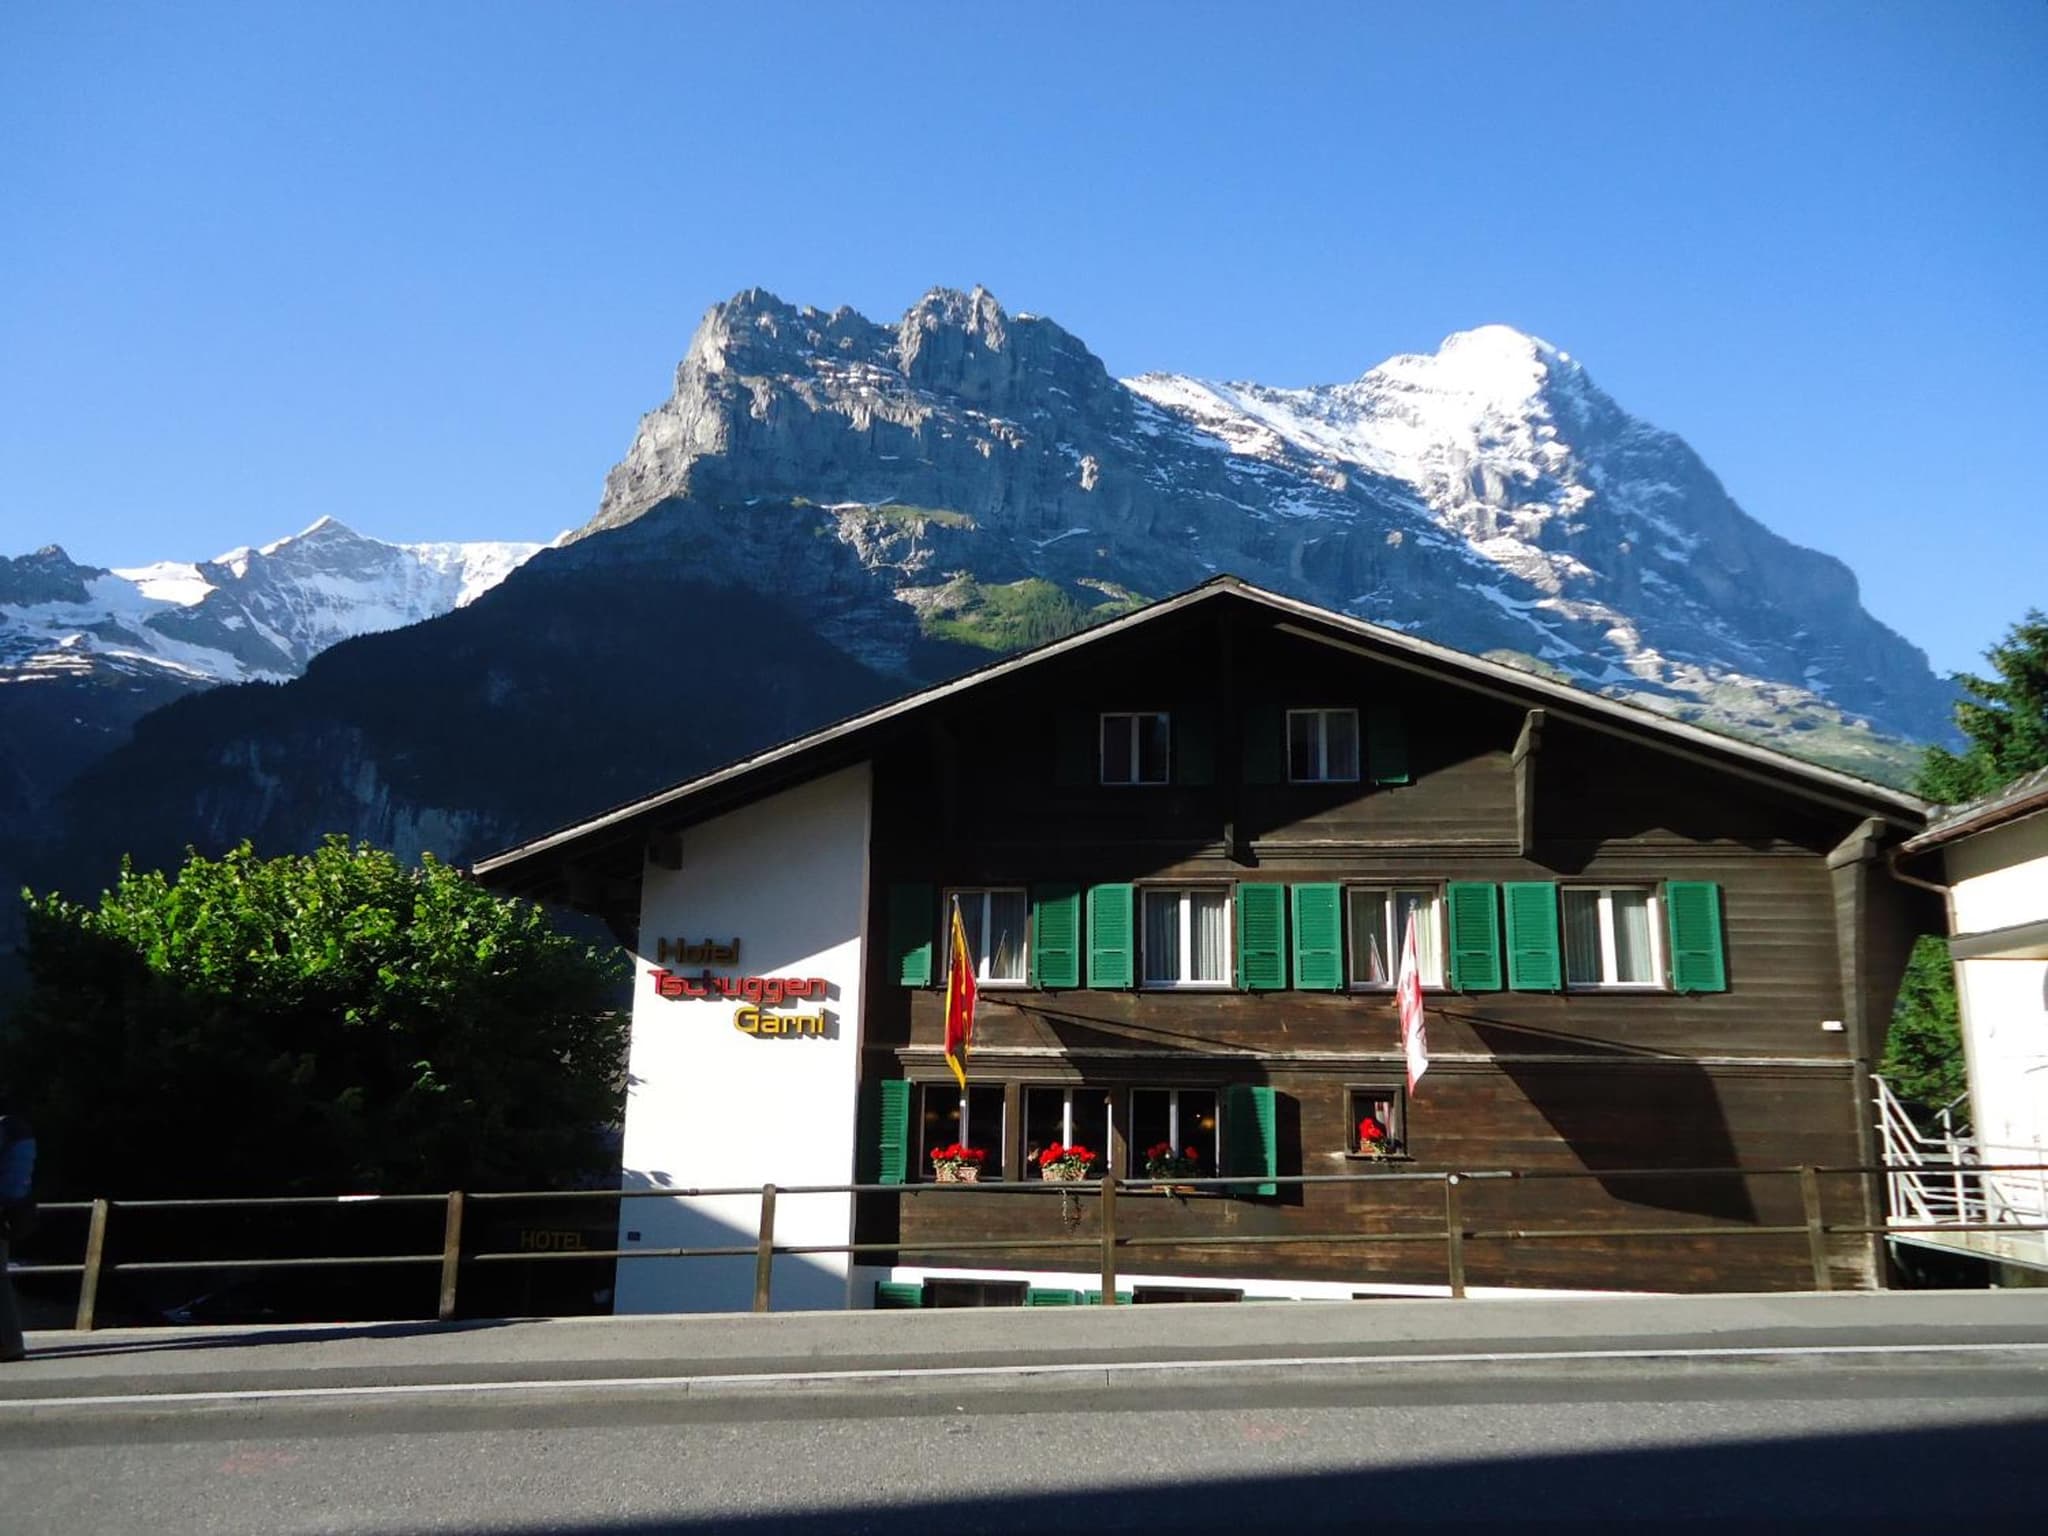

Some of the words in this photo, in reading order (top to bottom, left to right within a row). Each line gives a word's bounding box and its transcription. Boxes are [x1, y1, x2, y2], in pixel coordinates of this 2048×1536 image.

[658, 937, 740, 963] Hotel
[648, 969, 827, 1003] Tschuggen
[733, 1006, 826, 1034] Garni
[520, 1230, 588, 1249] HOTEL
